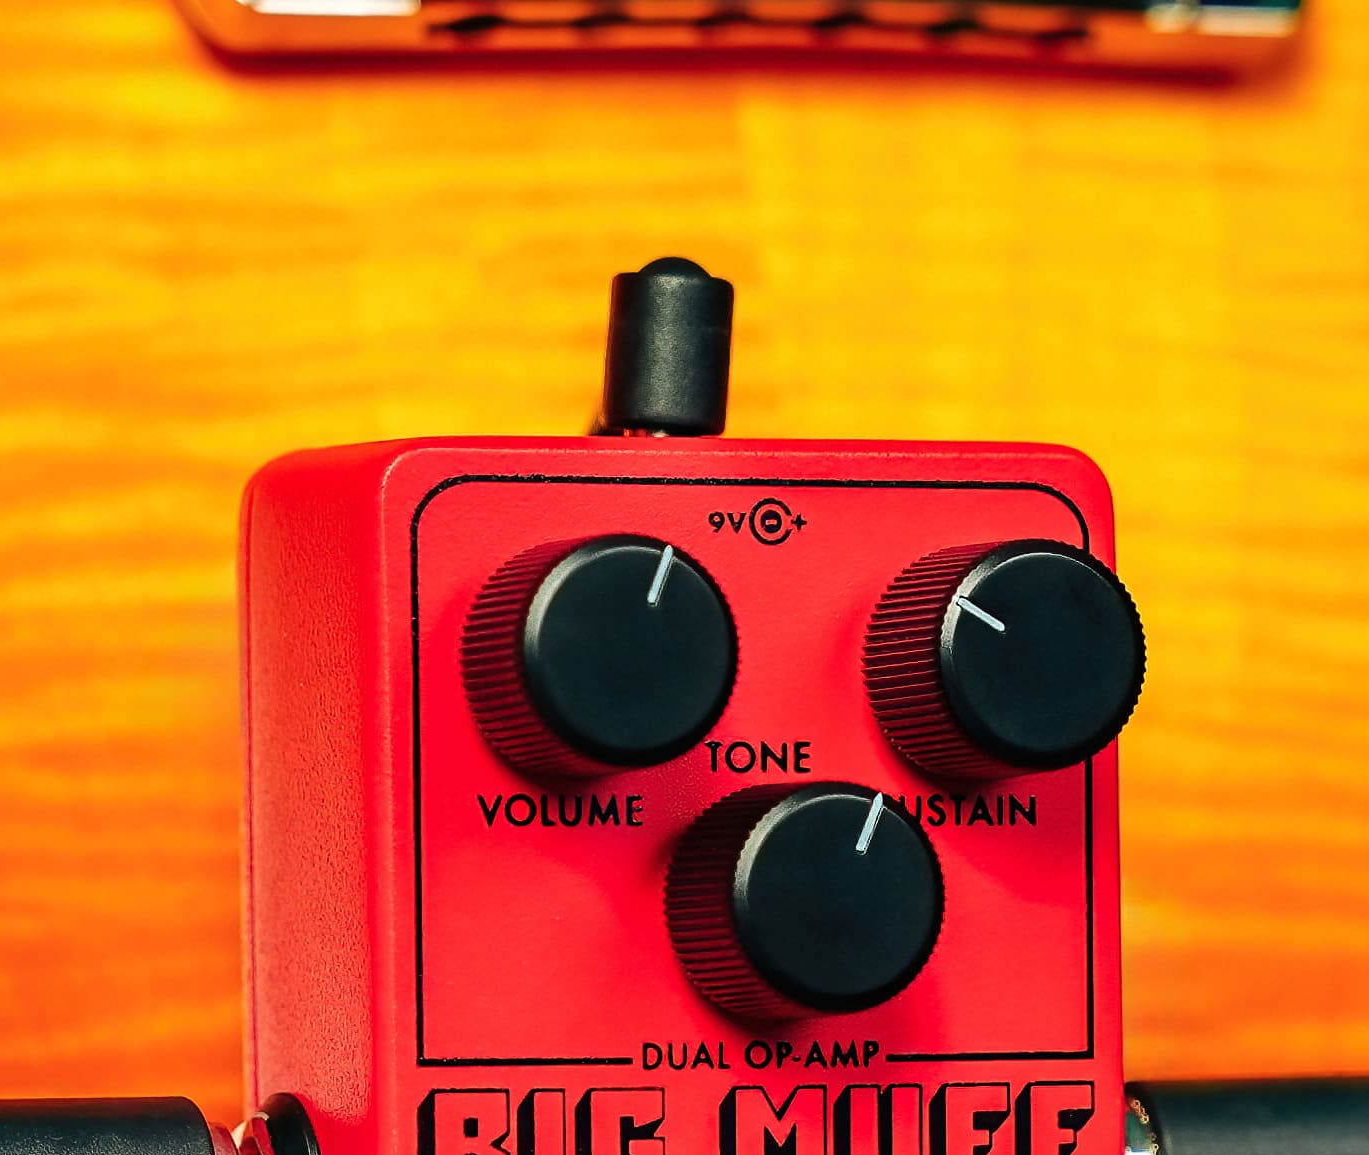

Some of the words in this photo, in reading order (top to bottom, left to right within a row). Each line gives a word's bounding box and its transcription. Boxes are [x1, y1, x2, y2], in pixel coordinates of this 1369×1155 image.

[708, 511, 747, 534] 9V
[708, 741, 811, 774] TONE
[477, 794, 644, 828] VOLUME
[884, 793, 1038, 827] USTAIN
[642, 1041, 731, 1071] DUAL
[744, 1039, 881, 1070] OP-AMP
